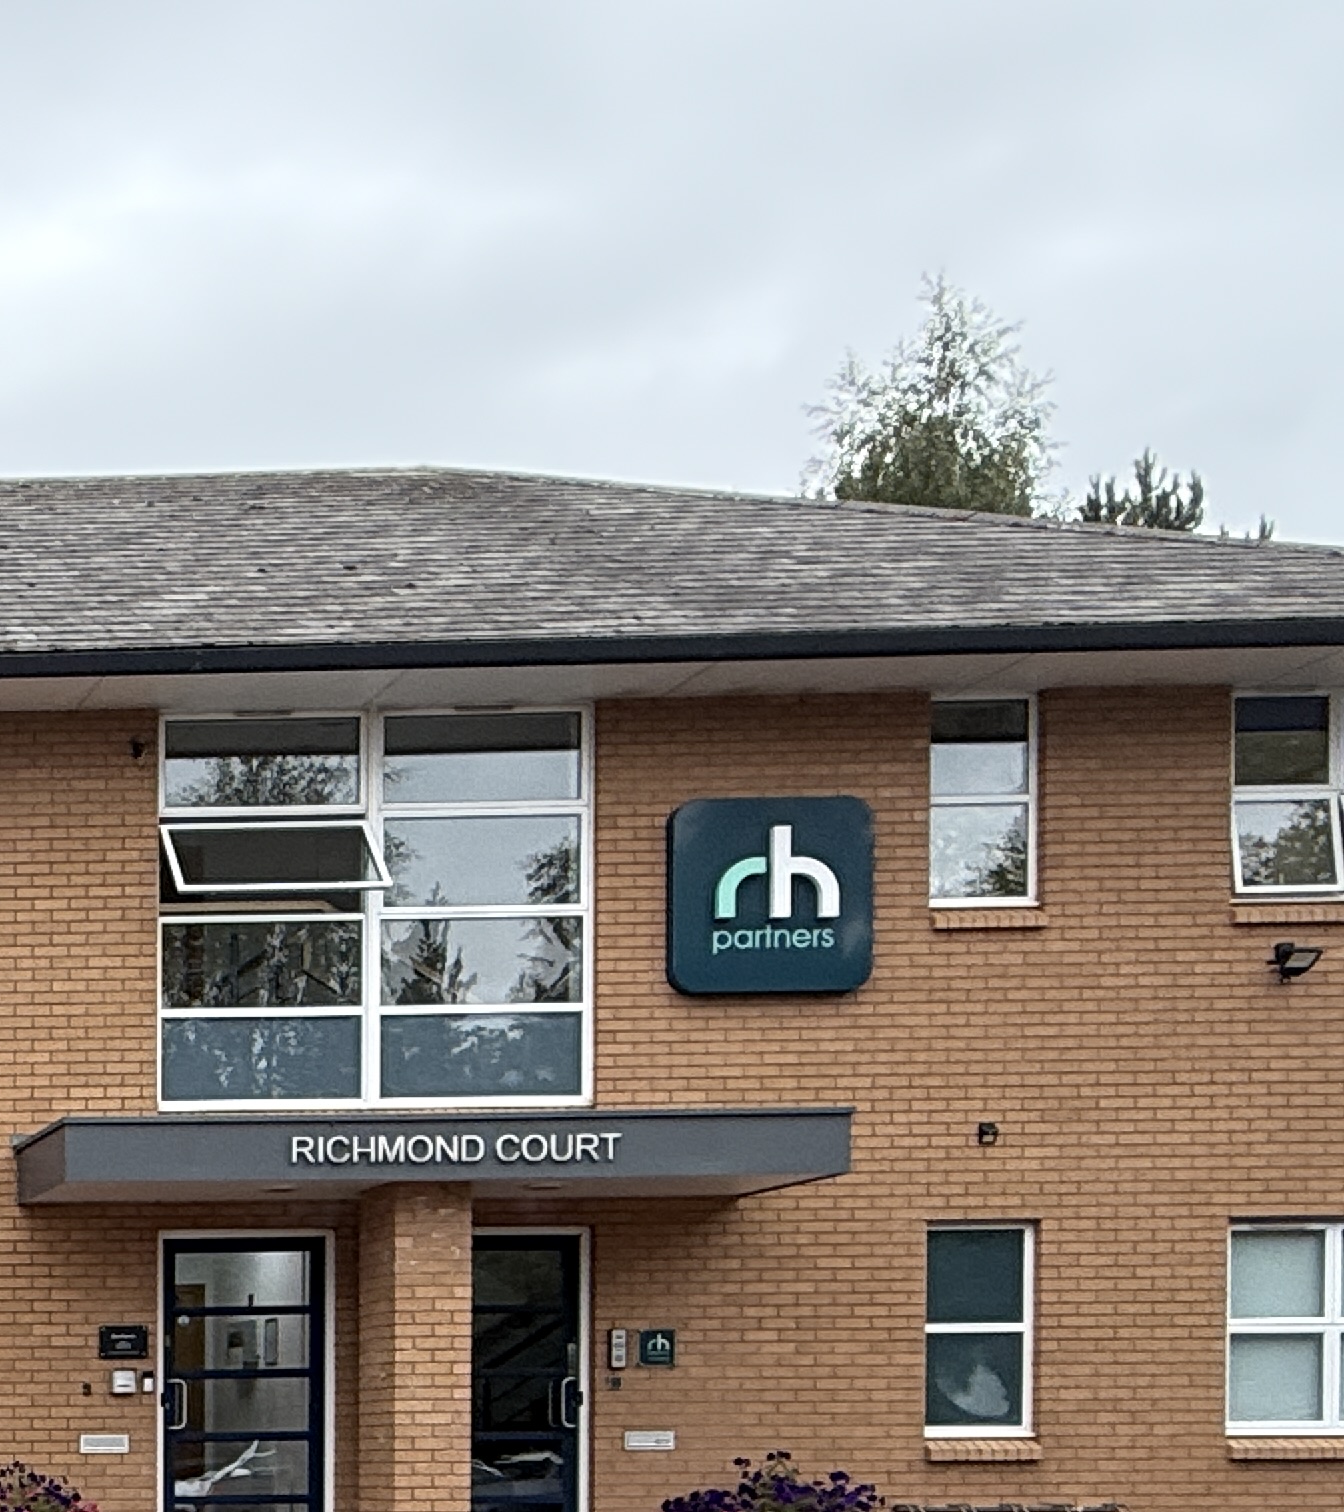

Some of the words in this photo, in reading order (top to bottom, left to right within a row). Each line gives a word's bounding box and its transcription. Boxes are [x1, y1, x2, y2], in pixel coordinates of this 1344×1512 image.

[714, 824, 841, 919] rh
[712, 924, 835, 956] partners
[291, 1134, 485, 1164] RICHMOND
[495, 1132, 623, 1162] COURT
